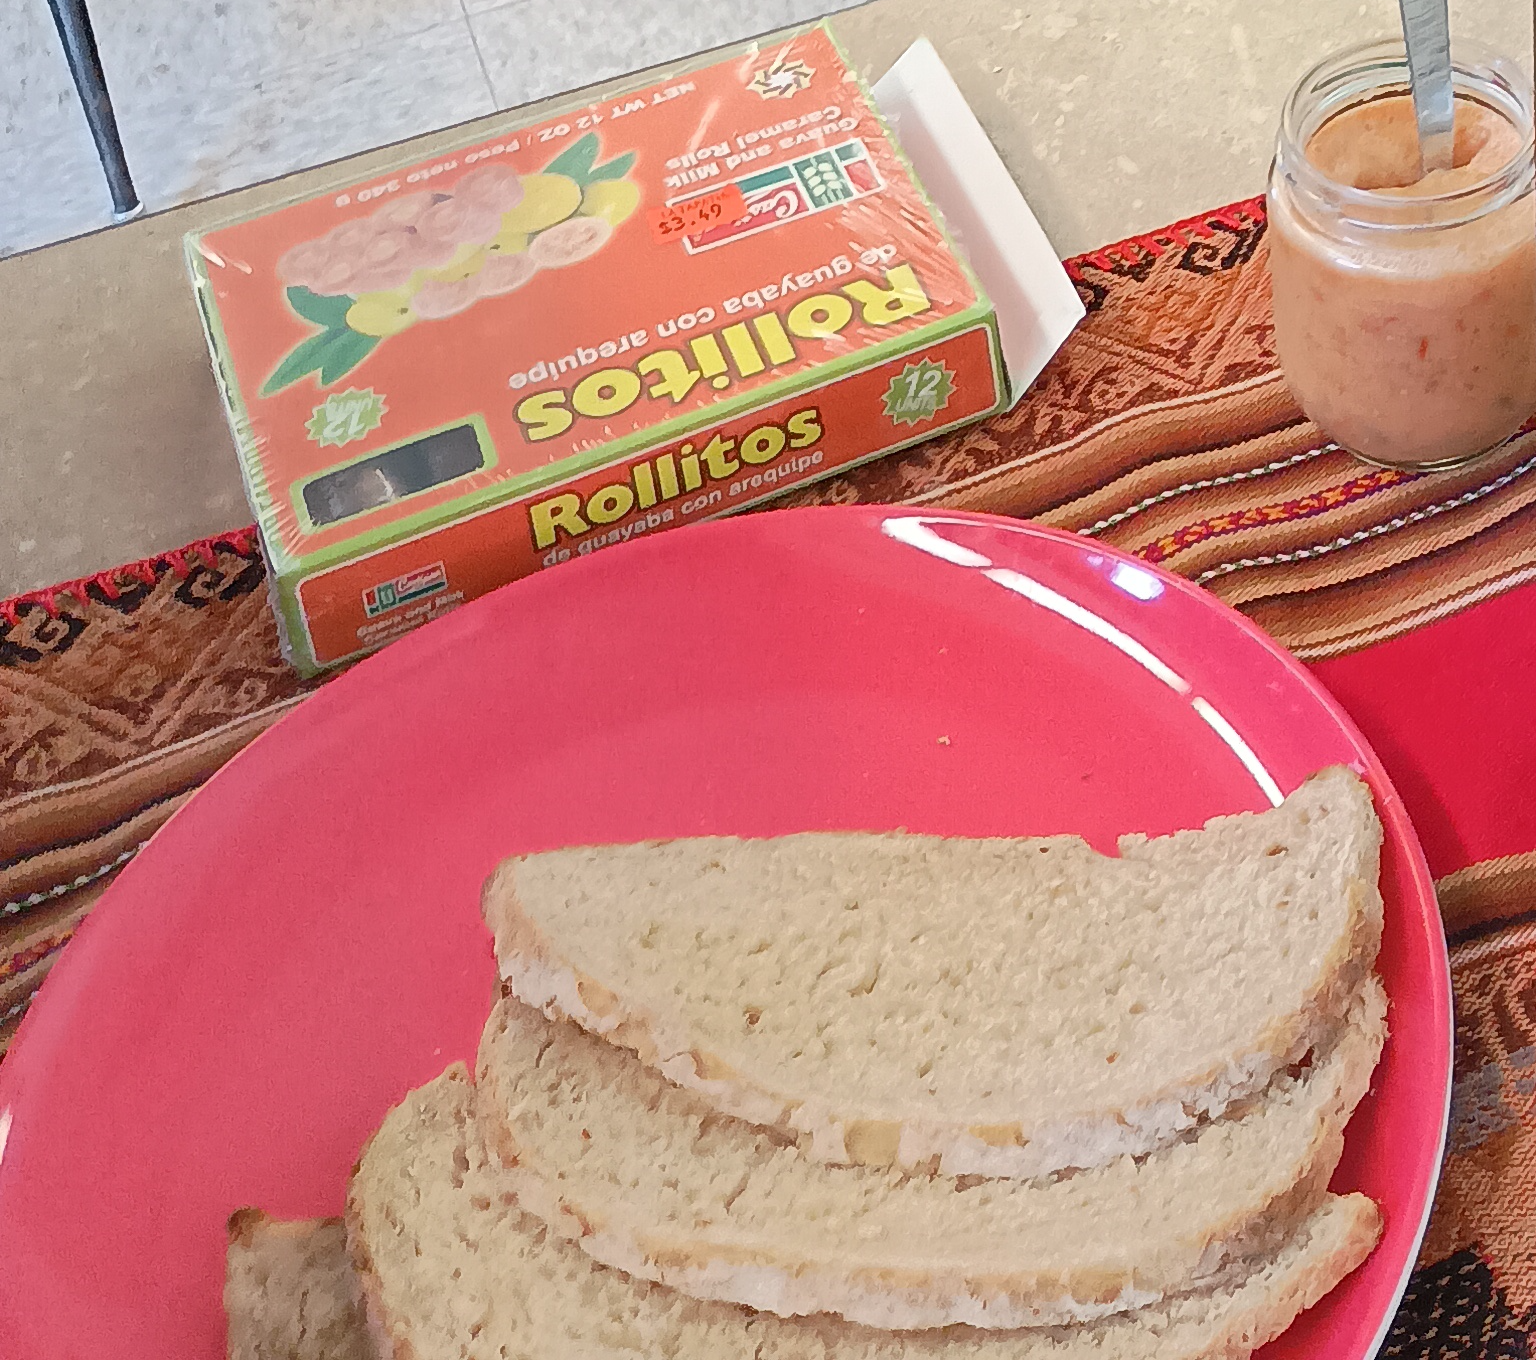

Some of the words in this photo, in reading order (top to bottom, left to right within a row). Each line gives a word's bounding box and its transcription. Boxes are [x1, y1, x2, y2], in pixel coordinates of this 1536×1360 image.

[652, 81, 697, 106] NET
[665, 141, 731, 170] Rolls
[725, 144, 773, 170] and
[664, 161, 721, 188] Milk
[658, 203, 722, 235] $3.49
[860, 243, 898, 268] de
[721, 252, 853, 317] guayaba
[657, 306, 716, 338] con
[508, 327, 649, 390] arequipe
[514, 263, 932, 444] Rollitos
[904, 369, 942, 397] 12
[529, 406, 825, 552] Rollitos
[681, 488, 722, 517] con
[729, 450, 824, 498] arequipe
